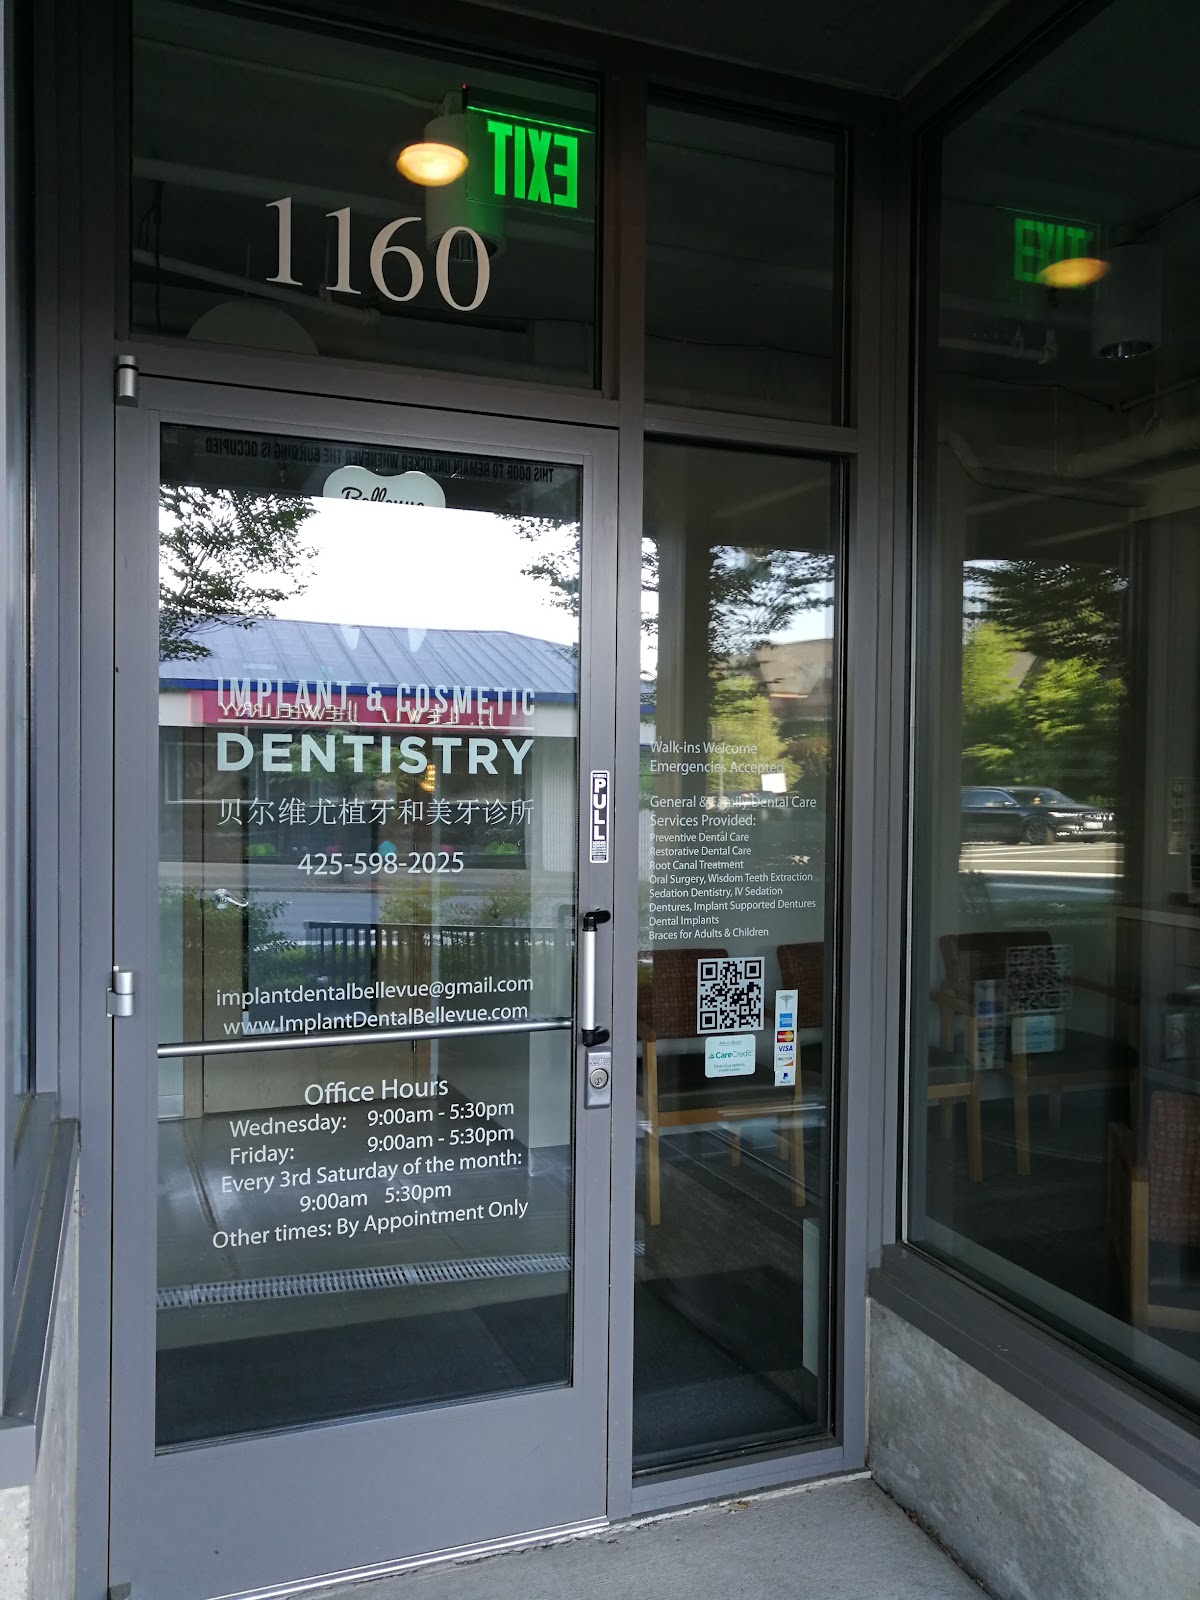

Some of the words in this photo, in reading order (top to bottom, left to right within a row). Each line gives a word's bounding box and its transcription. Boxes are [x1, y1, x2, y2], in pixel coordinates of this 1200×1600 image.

[265, 197, 490, 311] 1160
[218, 677, 350, 710] IMPLANT
[366, 682, 382, 712] &
[396, 682, 535, 716] COSMETIC
[217, 732, 535, 775] DENTISTRY
[650, 741, 700, 754] Walk-ins
[703, 742, 757, 755] Welcome
[650, 760, 726, 775] Emergencies
[730, 762, 784, 775] Accepted
[217, 797, 534, 826] 贝尔维尤植牙和美牙诊所
[593, 778, 607, 840] PULL
[650, 795, 696, 808] General
[751, 796, 789, 808] Dental
[791, 796, 816, 808] Care
[650, 814, 698, 827] Services
[701, 814, 756, 826] Provided:
[649, 832, 696, 843] Preventive
[699, 832, 728, 842] Dental
[730, 832, 749, 842] Care
[649, 846, 699, 856] Restorative
[701, 846, 730, 856] Dental
[732, 846, 752, 855] Care
[298, 852, 464, 875] 425-598-2025
[649, 861, 670, 870] Root
[672, 860, 697, 870] Canal
[699, 860, 744, 870] Treatment
[649, 874, 668, 884] Oral
[670, 874, 706, 886] Surgery,
[708, 873, 743, 883] Wisdom
[745, 873, 769, 882] Teeth
[770, 872, 813, 882] Extraction
[649, 888, 689, 898] Sedation
[691, 887, 733, 899] Dentistry,
[735, 887, 742, 896] IV
[745, 886, 783, 896] Sedation
[649, 902, 692, 913] Dentures,
[694, 901, 728, 913] Implant
[730, 900, 775, 912] Supported
[777, 899, 816, 909] Dentures
[649, 916, 678, 926] Dental
[681, 915, 719, 928] Implants
[649, 930, 677, 940] Braces
[679, 929, 692, 939] for
[694, 928, 722, 938] Adults
[724, 928, 731, 938] &
[732, 928, 769, 938] Children
[216, 976, 534, 1008] implantdentalbellevue@gmail.com
[223, 1004, 528, 1036] www.ImplantDentalBellevue.com
[715, 1050, 752, 1059] CareCredit
[304, 1081, 374, 1106] Office
[381, 1077, 449, 1101] Hours
[229, 1115, 347, 1138] Wednesday:
[367, 1107, 433, 1127] 9:00am
[449, 1101, 515, 1124] 5:30pm
[229, 1145, 295, 1166] Friday:
[367, 1132, 433, 1153] 9:00am
[449, 1126, 515, 1149] 5:30pm
[221, 1174, 274, 1197] Every
[279, 1166, 312, 1187] 3rd
[316, 1161, 398, 1186] Saturday
[403, 1157, 423, 1176] of
[426, 1154, 455, 1173] the
[460, 1150, 522, 1170] month:
[300, 1191, 368, 1212] 9:00am
[384, 1182, 451, 1205] 5:30pm
[212, 1229, 270, 1249] Other
[274, 1220, 332, 1242] times:
[337, 1218, 359, 1239] By
[364, 1202, 484, 1233] Appointment
[488, 1199, 529, 1222] Only
